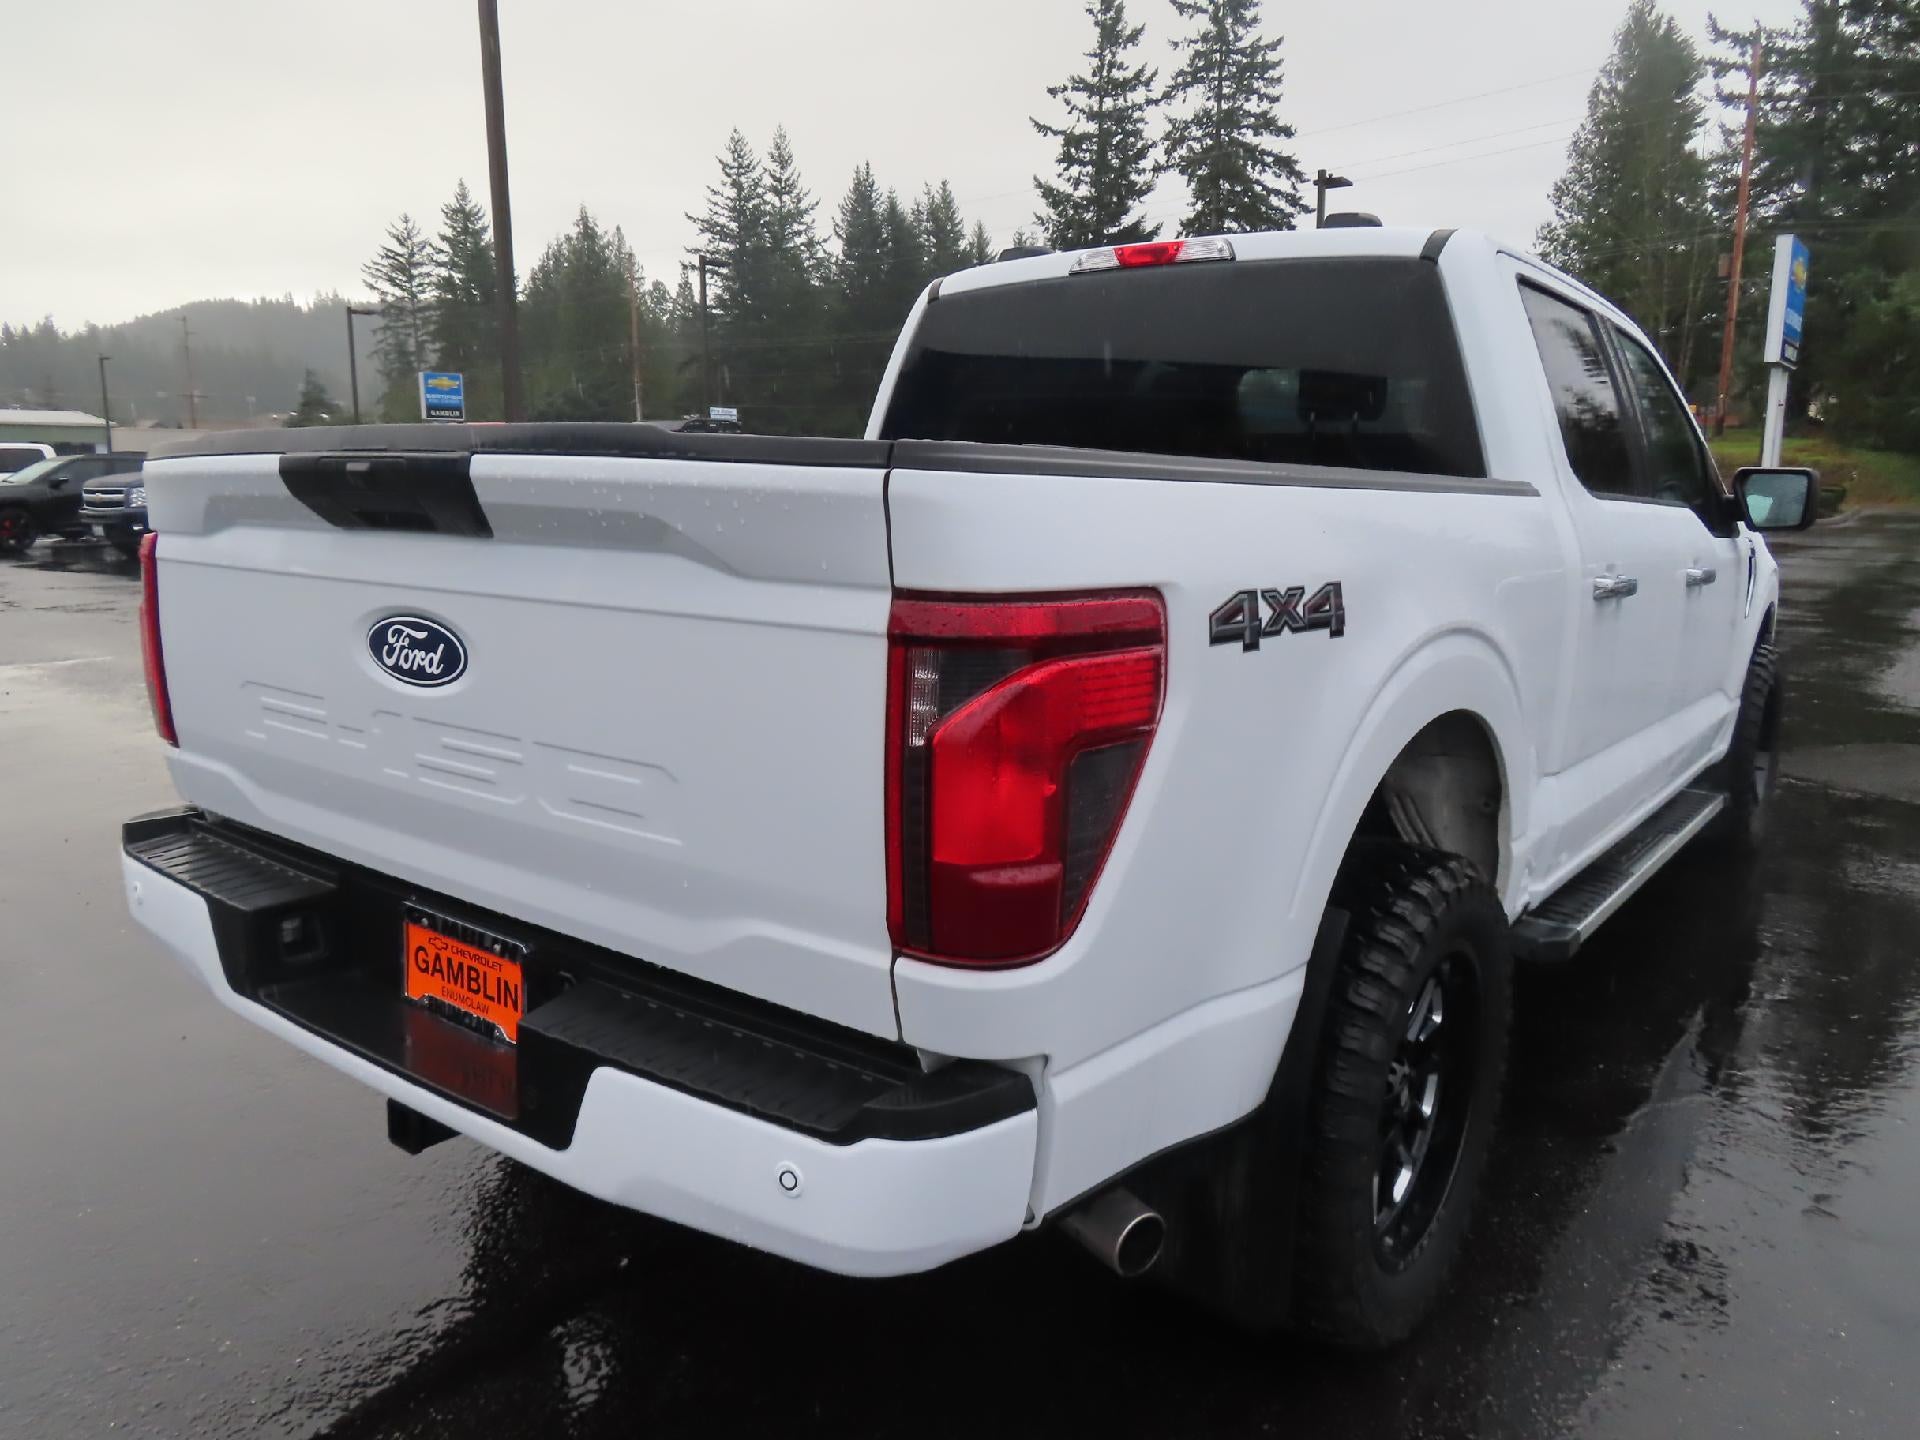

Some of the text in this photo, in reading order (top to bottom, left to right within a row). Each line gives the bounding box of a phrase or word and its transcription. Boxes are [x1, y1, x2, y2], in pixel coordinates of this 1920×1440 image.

[383, 624, 445, 675] Ford
[414, 946, 519, 1013] GAMBLIN
[451, 945, 503, 972] CHEVROLET
